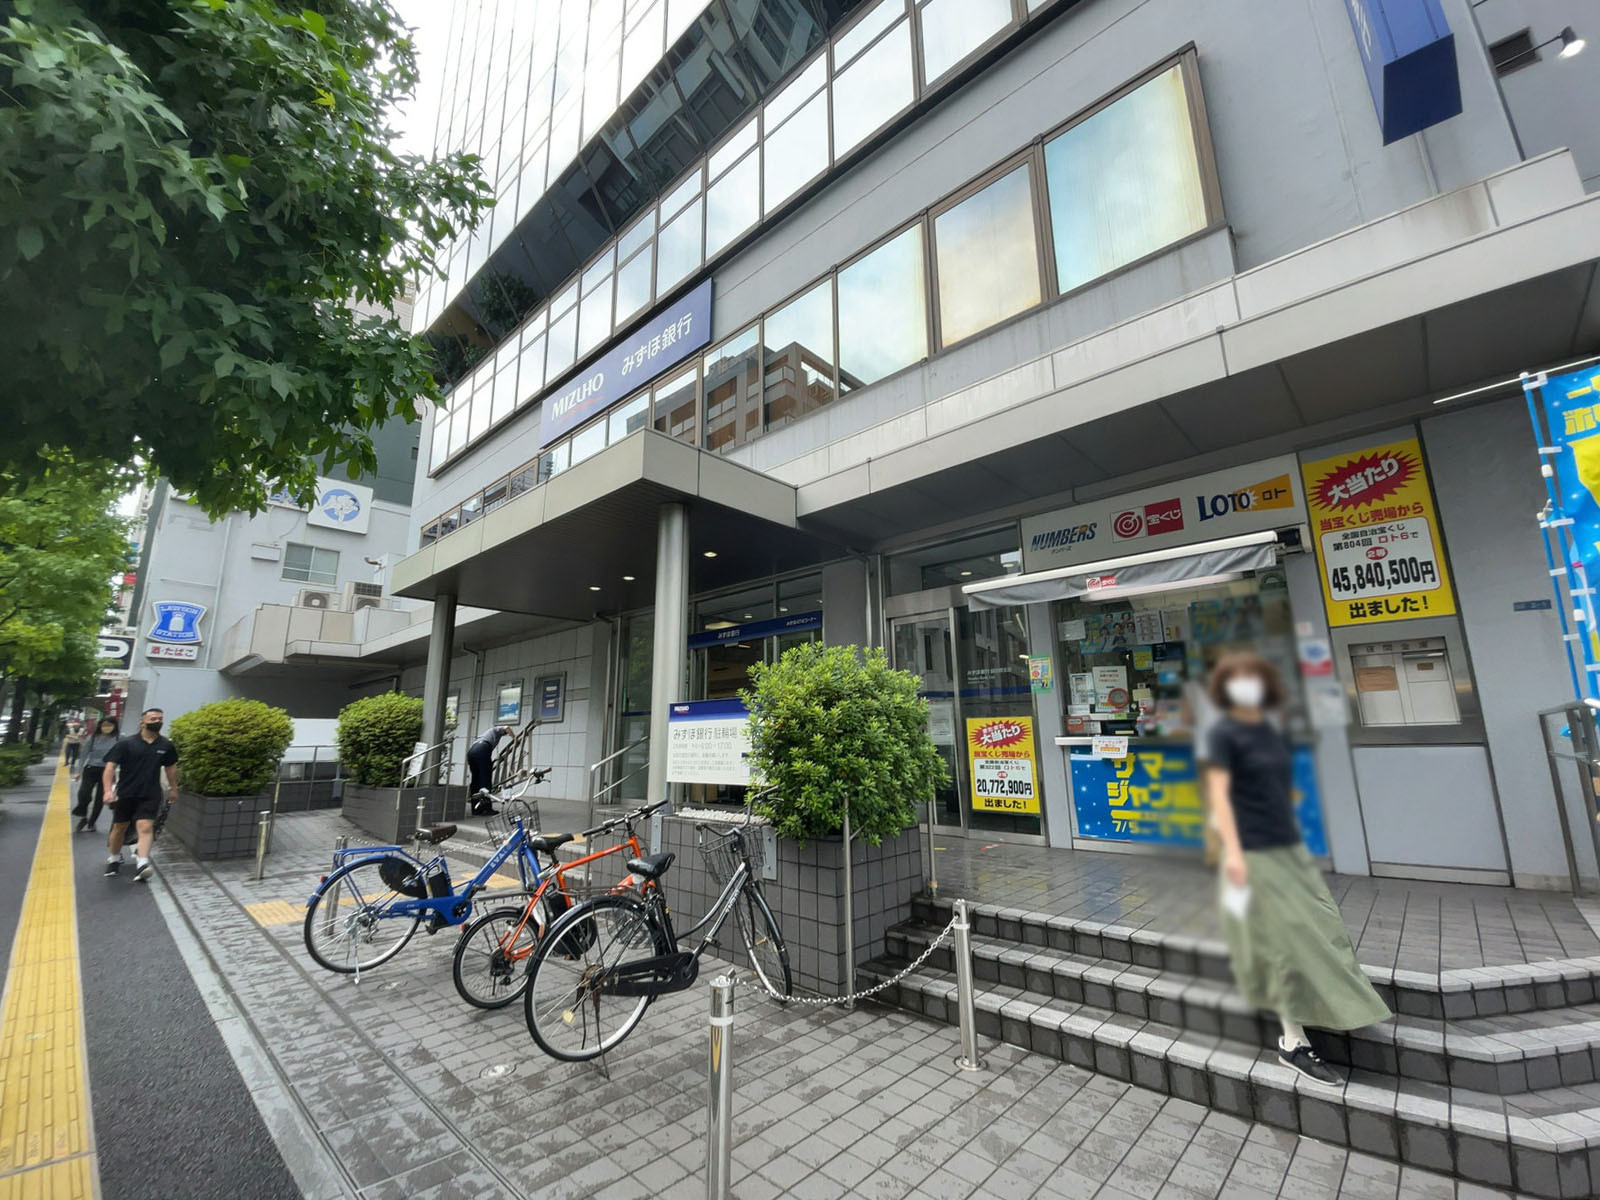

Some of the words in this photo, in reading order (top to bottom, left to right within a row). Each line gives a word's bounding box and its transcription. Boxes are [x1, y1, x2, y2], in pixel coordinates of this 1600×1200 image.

[552, 373, 604, 421] MIZUHO
[621, 312, 692, 376] みずほ銀行
[1328, 458, 1399, 505] 大当たり
[1262, 488, 1287, 501] ロト
[1197, 492, 1250, 522] LOTO
[1320, 502, 1425, 531] 当宝くじ売場から
[1146, 509, 1181, 526] 宝くじ
[1031, 522, 1098, 552] NUMBERS
[1341, 523, 1406, 540] 全国自治宝くじ
[1332, 537, 1373, 551] 第804回
[1332, 556, 1436, 594] 45,840,500円
[673, 727, 713, 740] みずほ銀行
[980, 725, 1021, 745] 大当たり
[976, 778, 1032, 796] 20,772,900円
